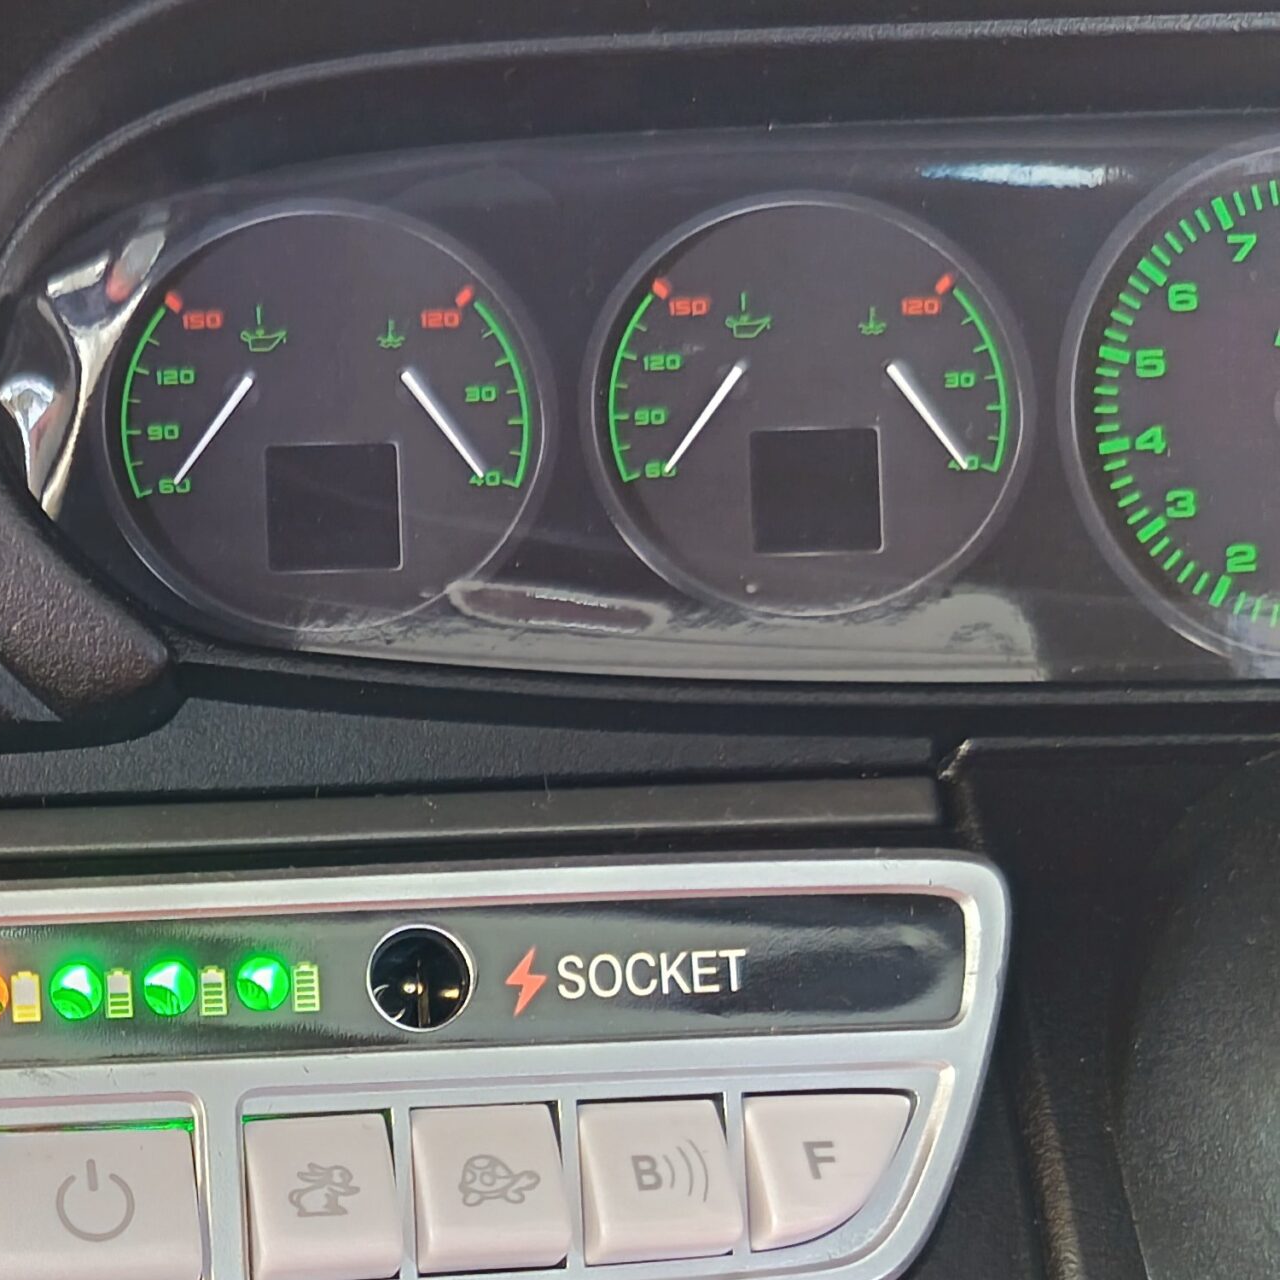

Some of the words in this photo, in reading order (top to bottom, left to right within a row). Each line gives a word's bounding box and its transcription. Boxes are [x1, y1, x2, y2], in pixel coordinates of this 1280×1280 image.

[1227, 232, 1258, 262] 7
[669, 298, 709, 315] 150
[902, 297, 941, 315] 120
[1168, 281, 1200, 312] 6
[183, 312, 222, 330] 150
[422, 310, 461, 328] 120
[644, 352, 683, 370] 120
[1136, 349, 1165, 377] 5
[157, 368, 194, 385] 120
[634, 407, 668, 425] 90
[148, 424, 179, 440] 90
[1136, 426, 1166, 454] 4
[1166, 490, 1196, 518] 3
[1226, 544, 1256, 572] 2
[558, 949, 746, 998] SOCKET
[803, 1141, 836, 1180] F
